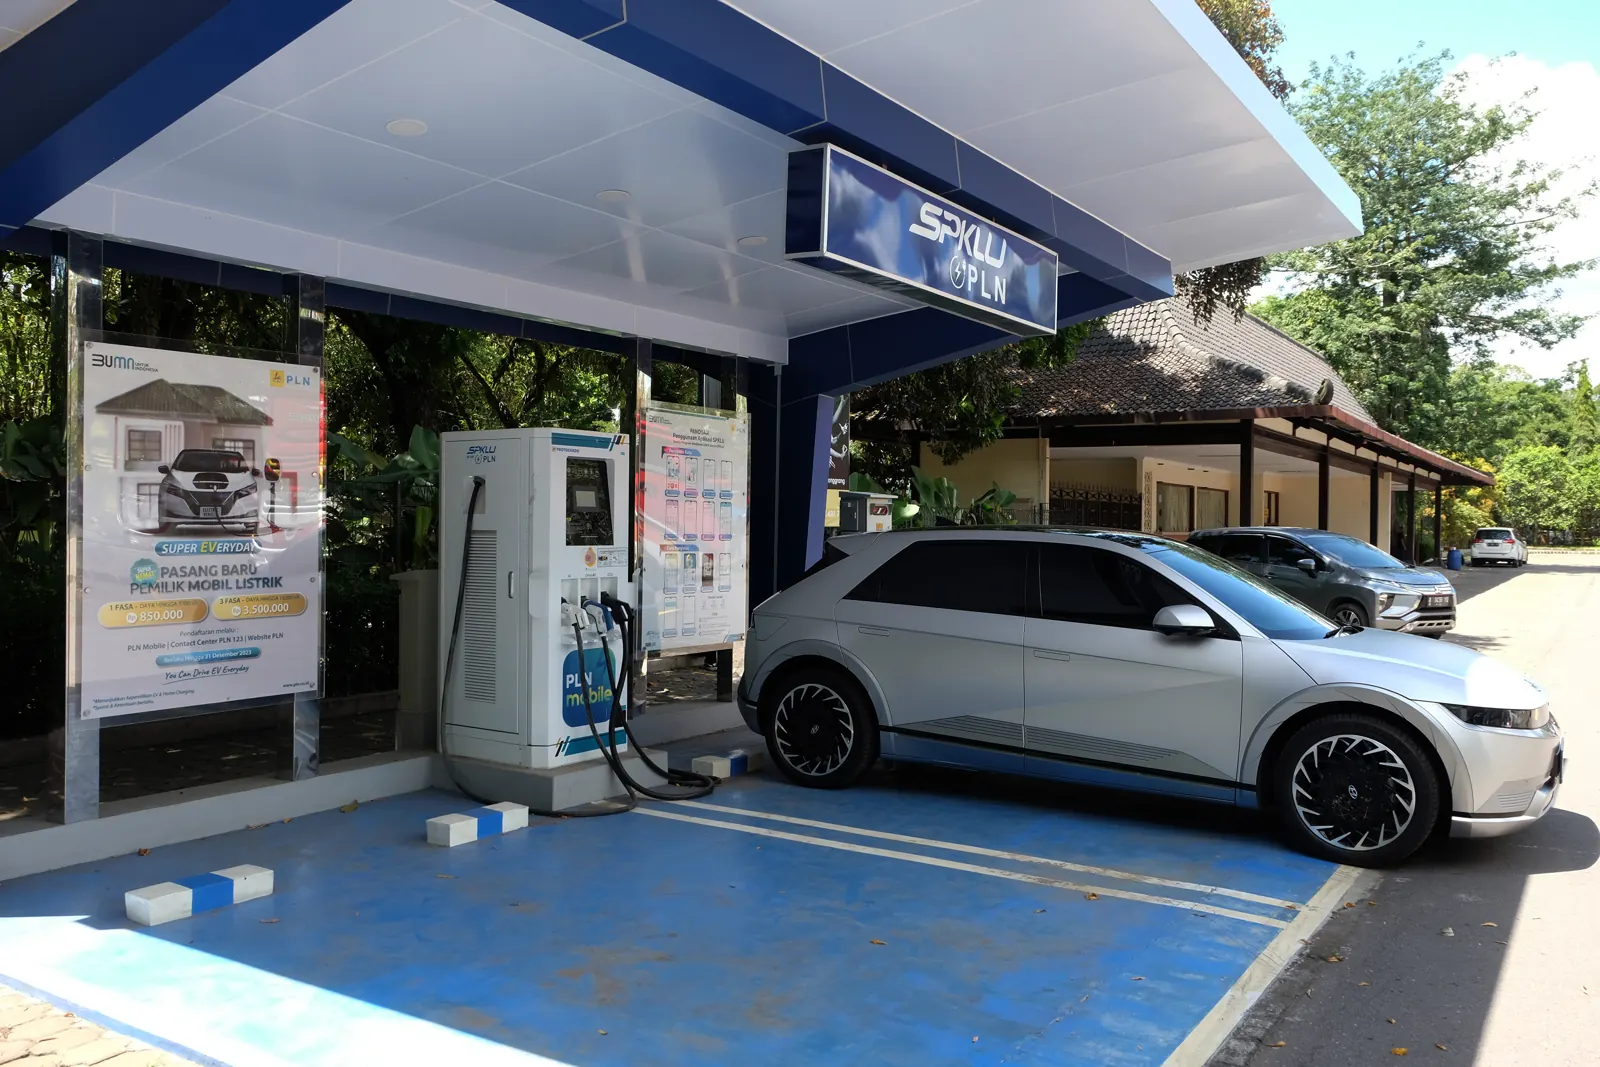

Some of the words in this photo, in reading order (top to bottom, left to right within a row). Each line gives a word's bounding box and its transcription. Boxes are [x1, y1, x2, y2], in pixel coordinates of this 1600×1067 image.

[909, 202, 1007, 268] SPKLU
[968, 264, 1006, 305] PLN
[286, 376, 310, 386] PLN
[162, 544, 197, 554] SUPER
[201, 542, 256, 553] EVERYDAY
[160, 565, 218, 578] PASANG
[222, 564, 257, 576] BARU
[130, 581, 185, 594] PEMILIK
[188, 579, 232, 591] MOBIL
[236, 576, 283, 589] LISTRIK
[243, 603, 289, 614] 3.500.000
[140, 610, 183, 621] 850.000
[193, 669, 209, 677] Drive
[222, 664, 249, 674] Everyday
[566, 672, 592, 688] PLN
